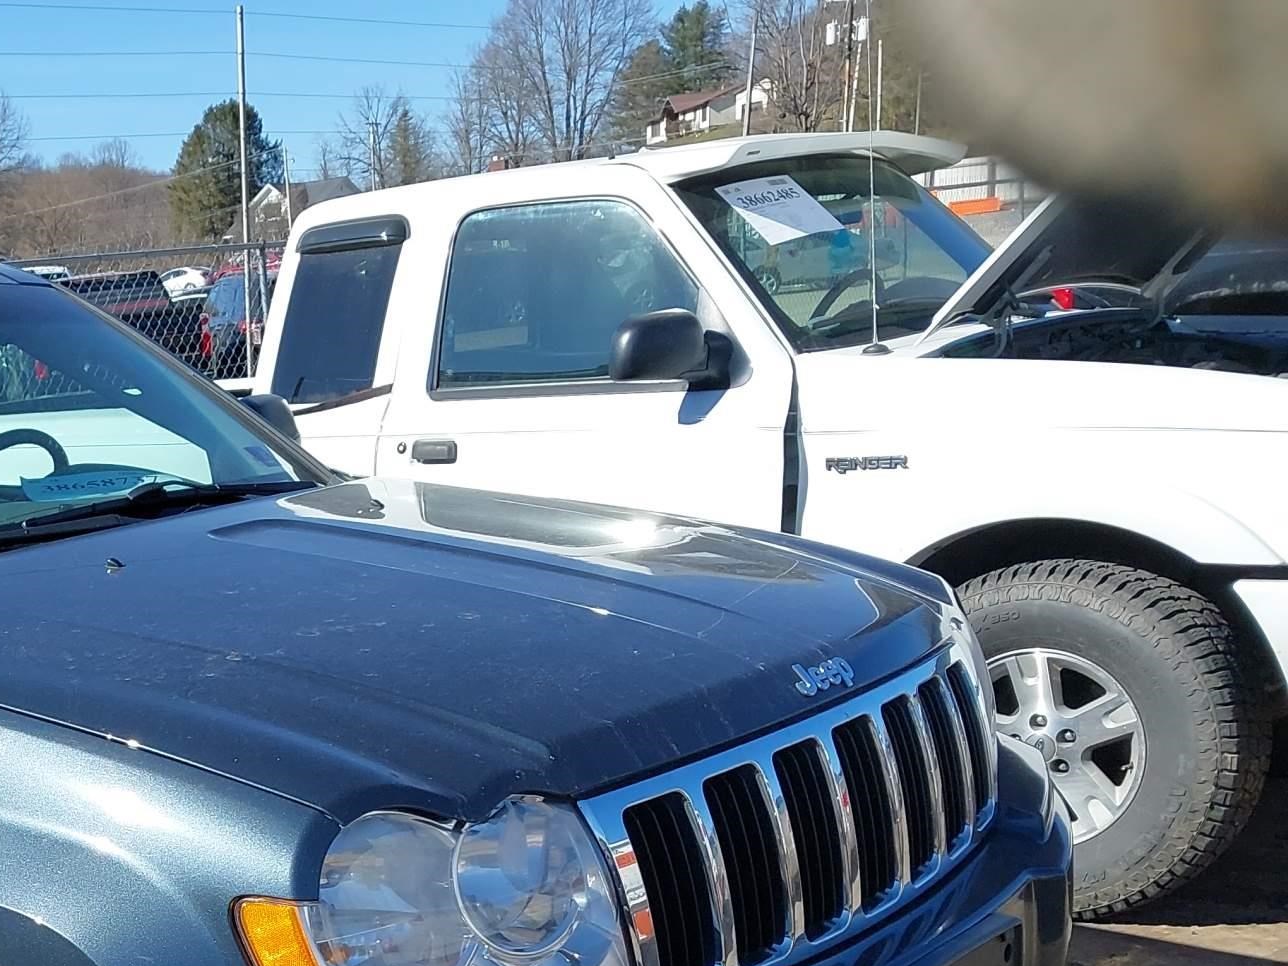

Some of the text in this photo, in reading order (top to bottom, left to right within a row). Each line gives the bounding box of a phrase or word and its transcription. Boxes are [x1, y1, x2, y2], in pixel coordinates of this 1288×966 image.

[736, 187, 801, 208] 38662485
[825, 455, 909, 474] RANGER
[791, 656, 855, 697] Jeep
